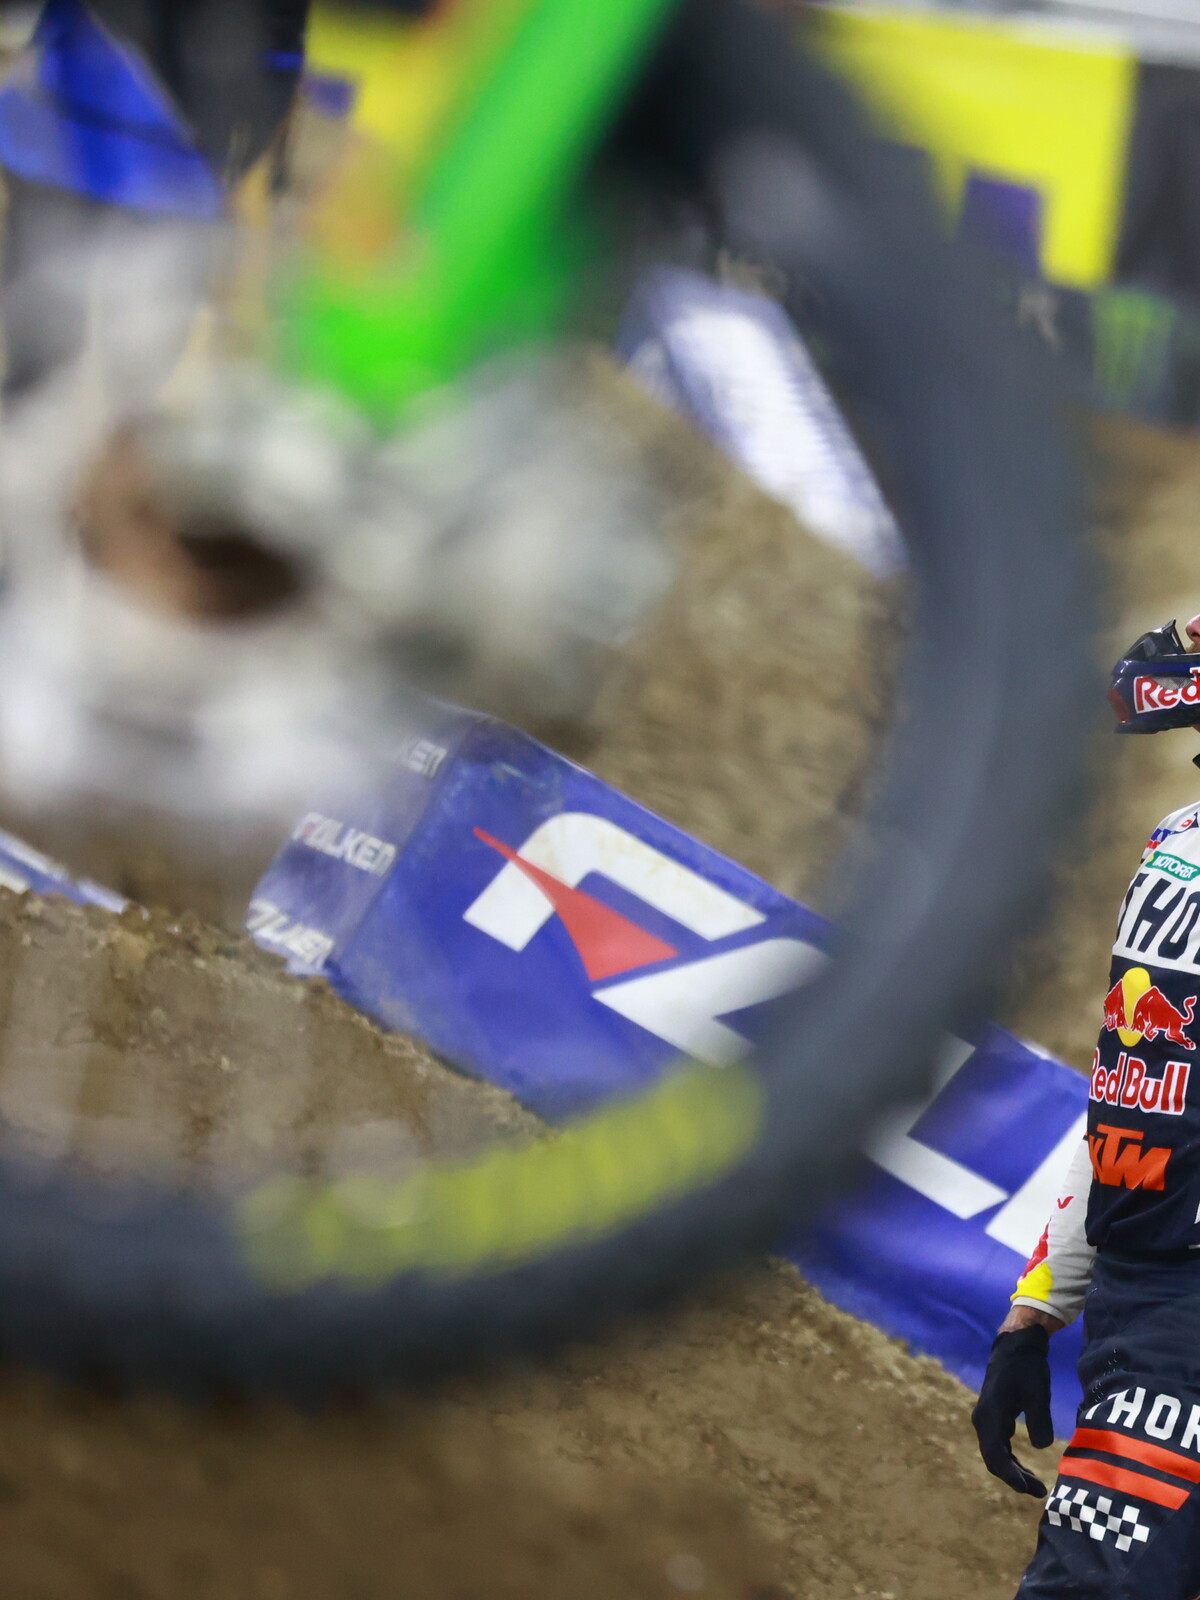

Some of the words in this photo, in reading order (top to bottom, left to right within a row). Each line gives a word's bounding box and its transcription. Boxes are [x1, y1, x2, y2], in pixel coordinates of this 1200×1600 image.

[1089, 1047, 1127, 1106] Red
[1120, 1056, 1191, 1116] Bull
[1085, 1123, 1172, 1192] KTM
